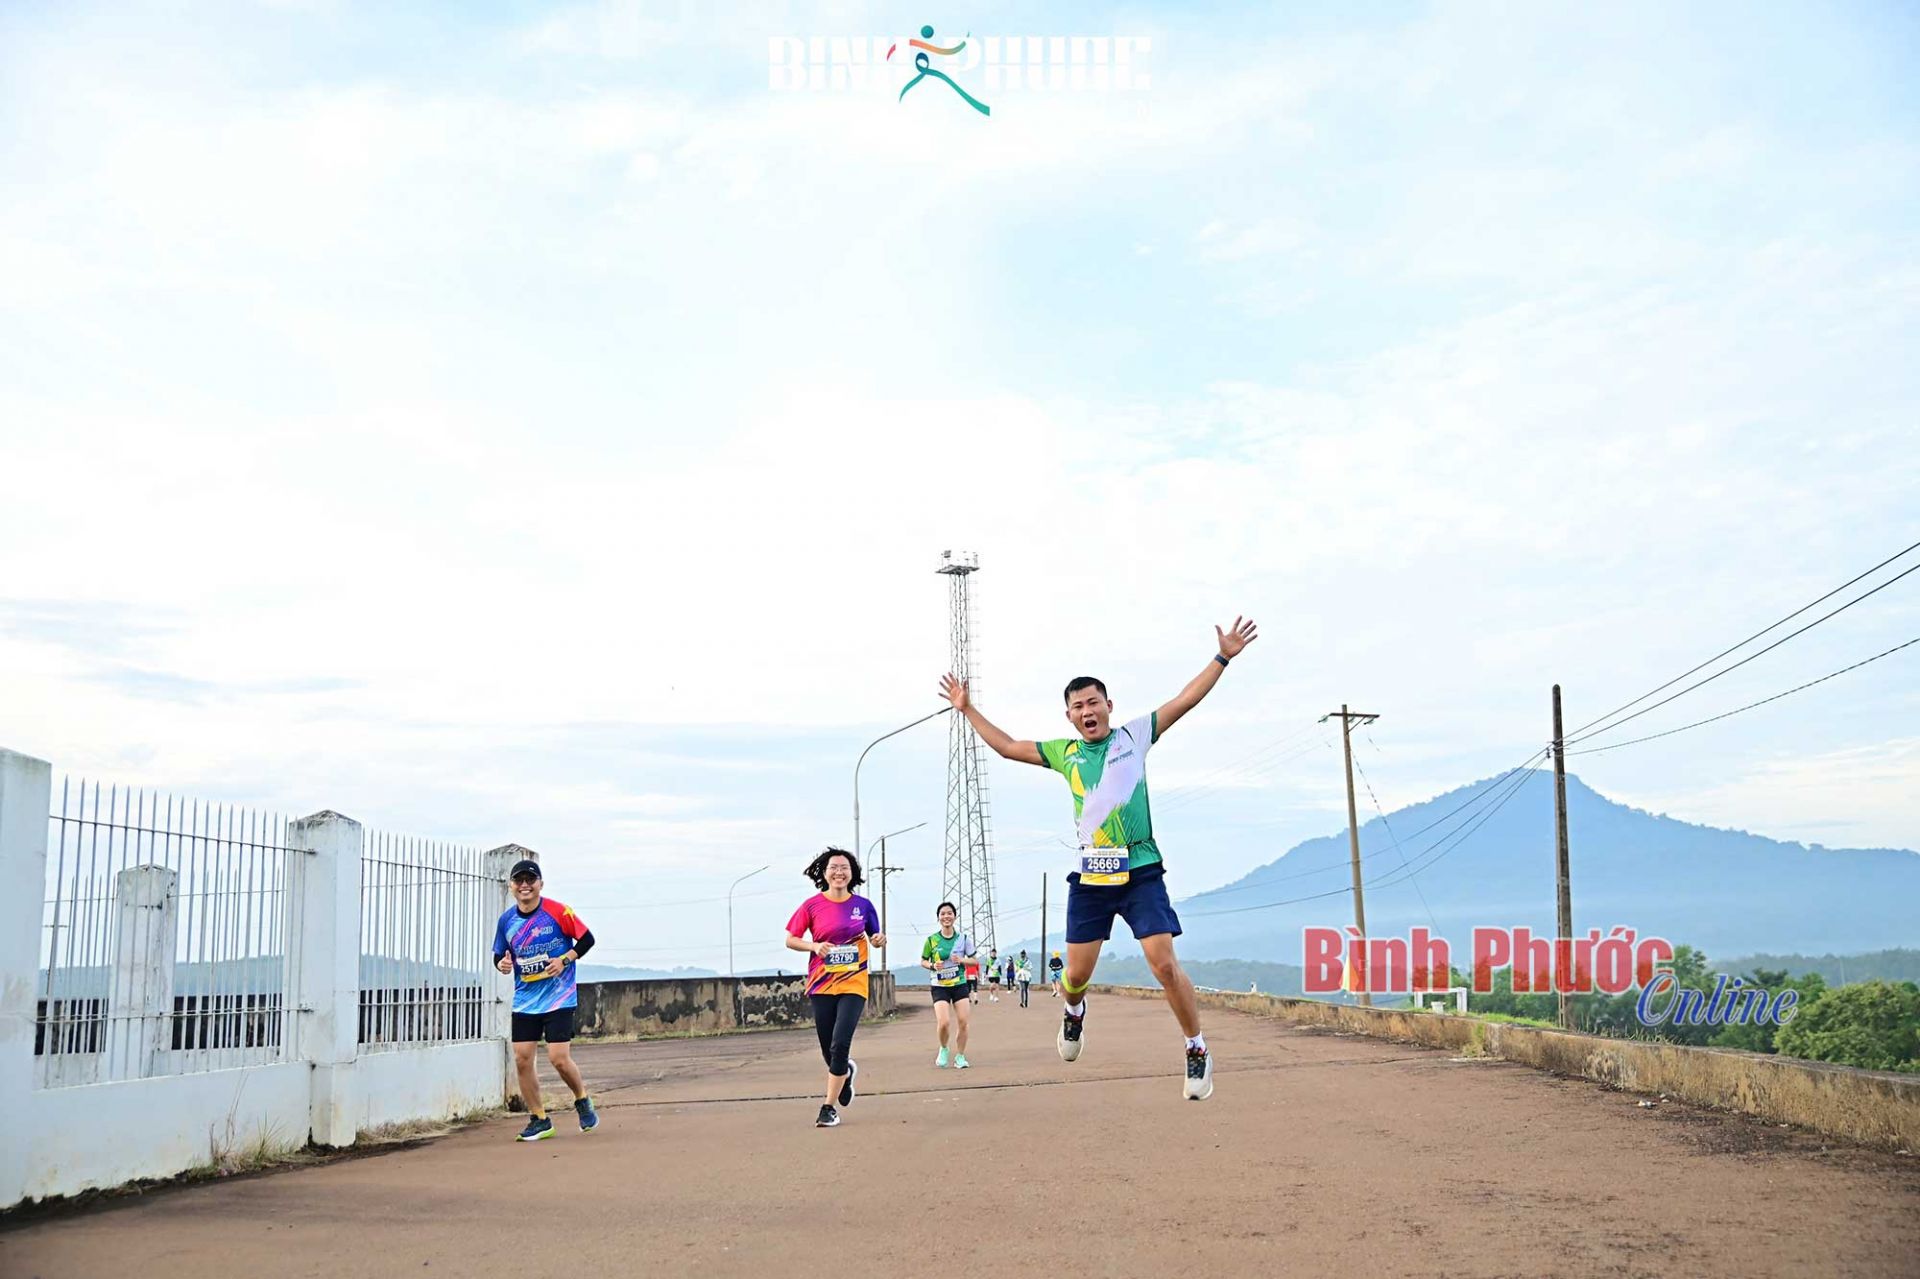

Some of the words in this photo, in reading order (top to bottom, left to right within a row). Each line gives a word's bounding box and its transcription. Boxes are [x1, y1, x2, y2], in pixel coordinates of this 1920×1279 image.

[1087, 858, 1120, 870] 25669
[829, 953, 854, 963] 25790
[520, 961, 544, 973] 25771
